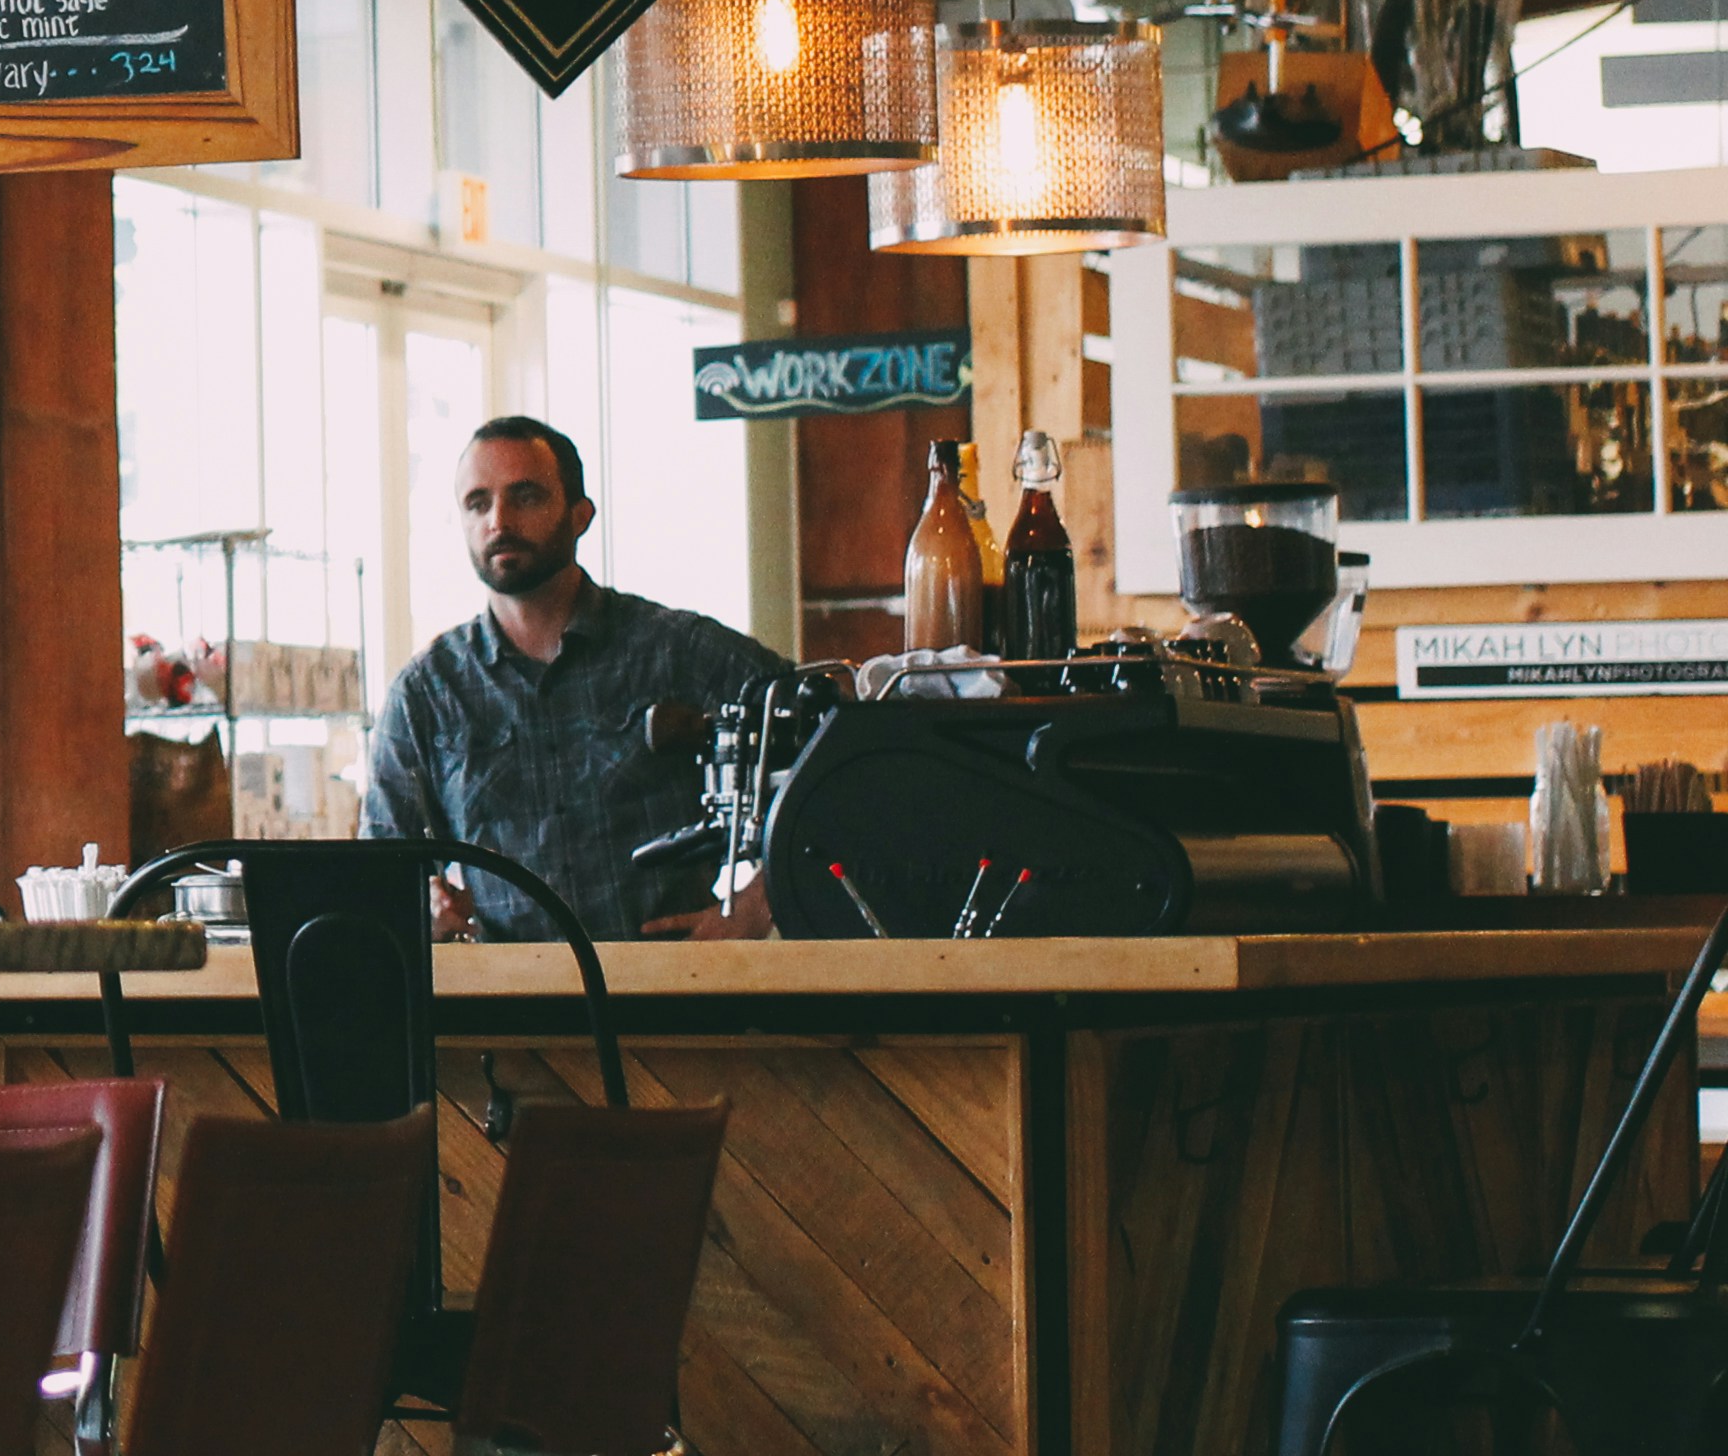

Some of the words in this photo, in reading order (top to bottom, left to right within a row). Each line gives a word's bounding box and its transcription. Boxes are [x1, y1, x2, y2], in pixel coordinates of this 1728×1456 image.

[21, 14, 79, 38] mint
[110, 49, 176, 83] 324
[1414, 633, 1524, 661] MIKAH
[1538, 632, 1602, 660] LYN
